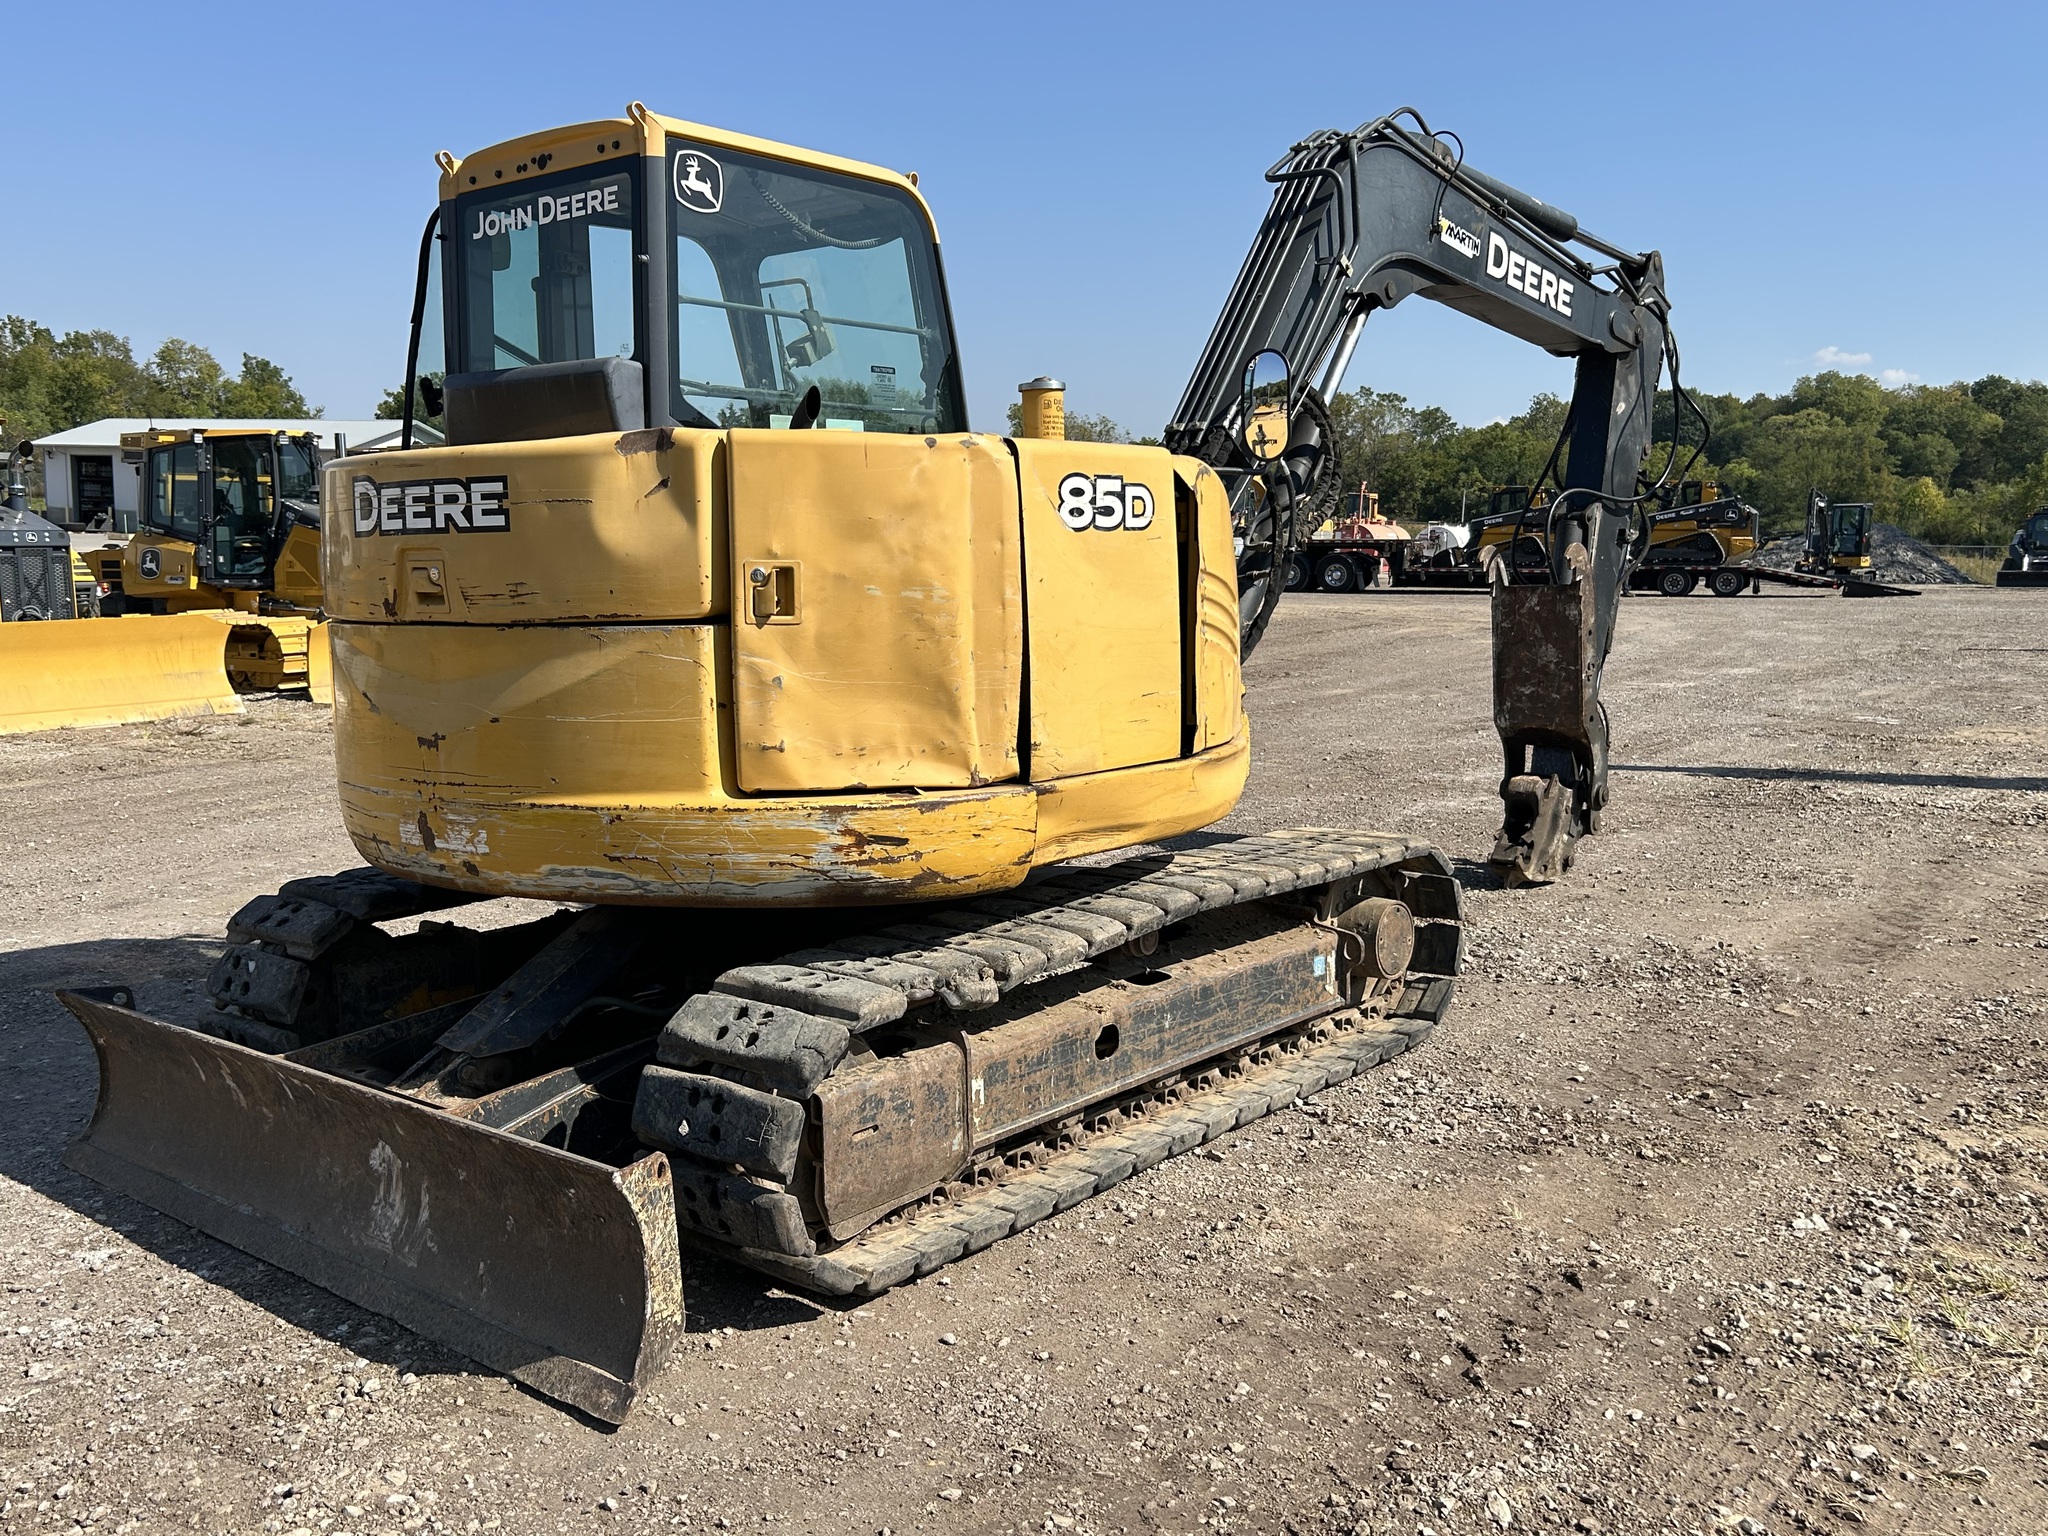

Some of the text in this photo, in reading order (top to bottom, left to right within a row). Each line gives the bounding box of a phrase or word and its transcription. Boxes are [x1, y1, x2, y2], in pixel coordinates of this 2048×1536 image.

[472, 184, 619, 240] JOHN DEERE
[1445, 222, 1480, 255] MARTIN
[1486, 230, 1574, 317] DEERE
[352, 476, 509, 537] DEERE
[1058, 472, 1155, 532] 85D
[1483, 517, 1503, 525] DEERE
[1655, 512, 1676, 521] DEERE
